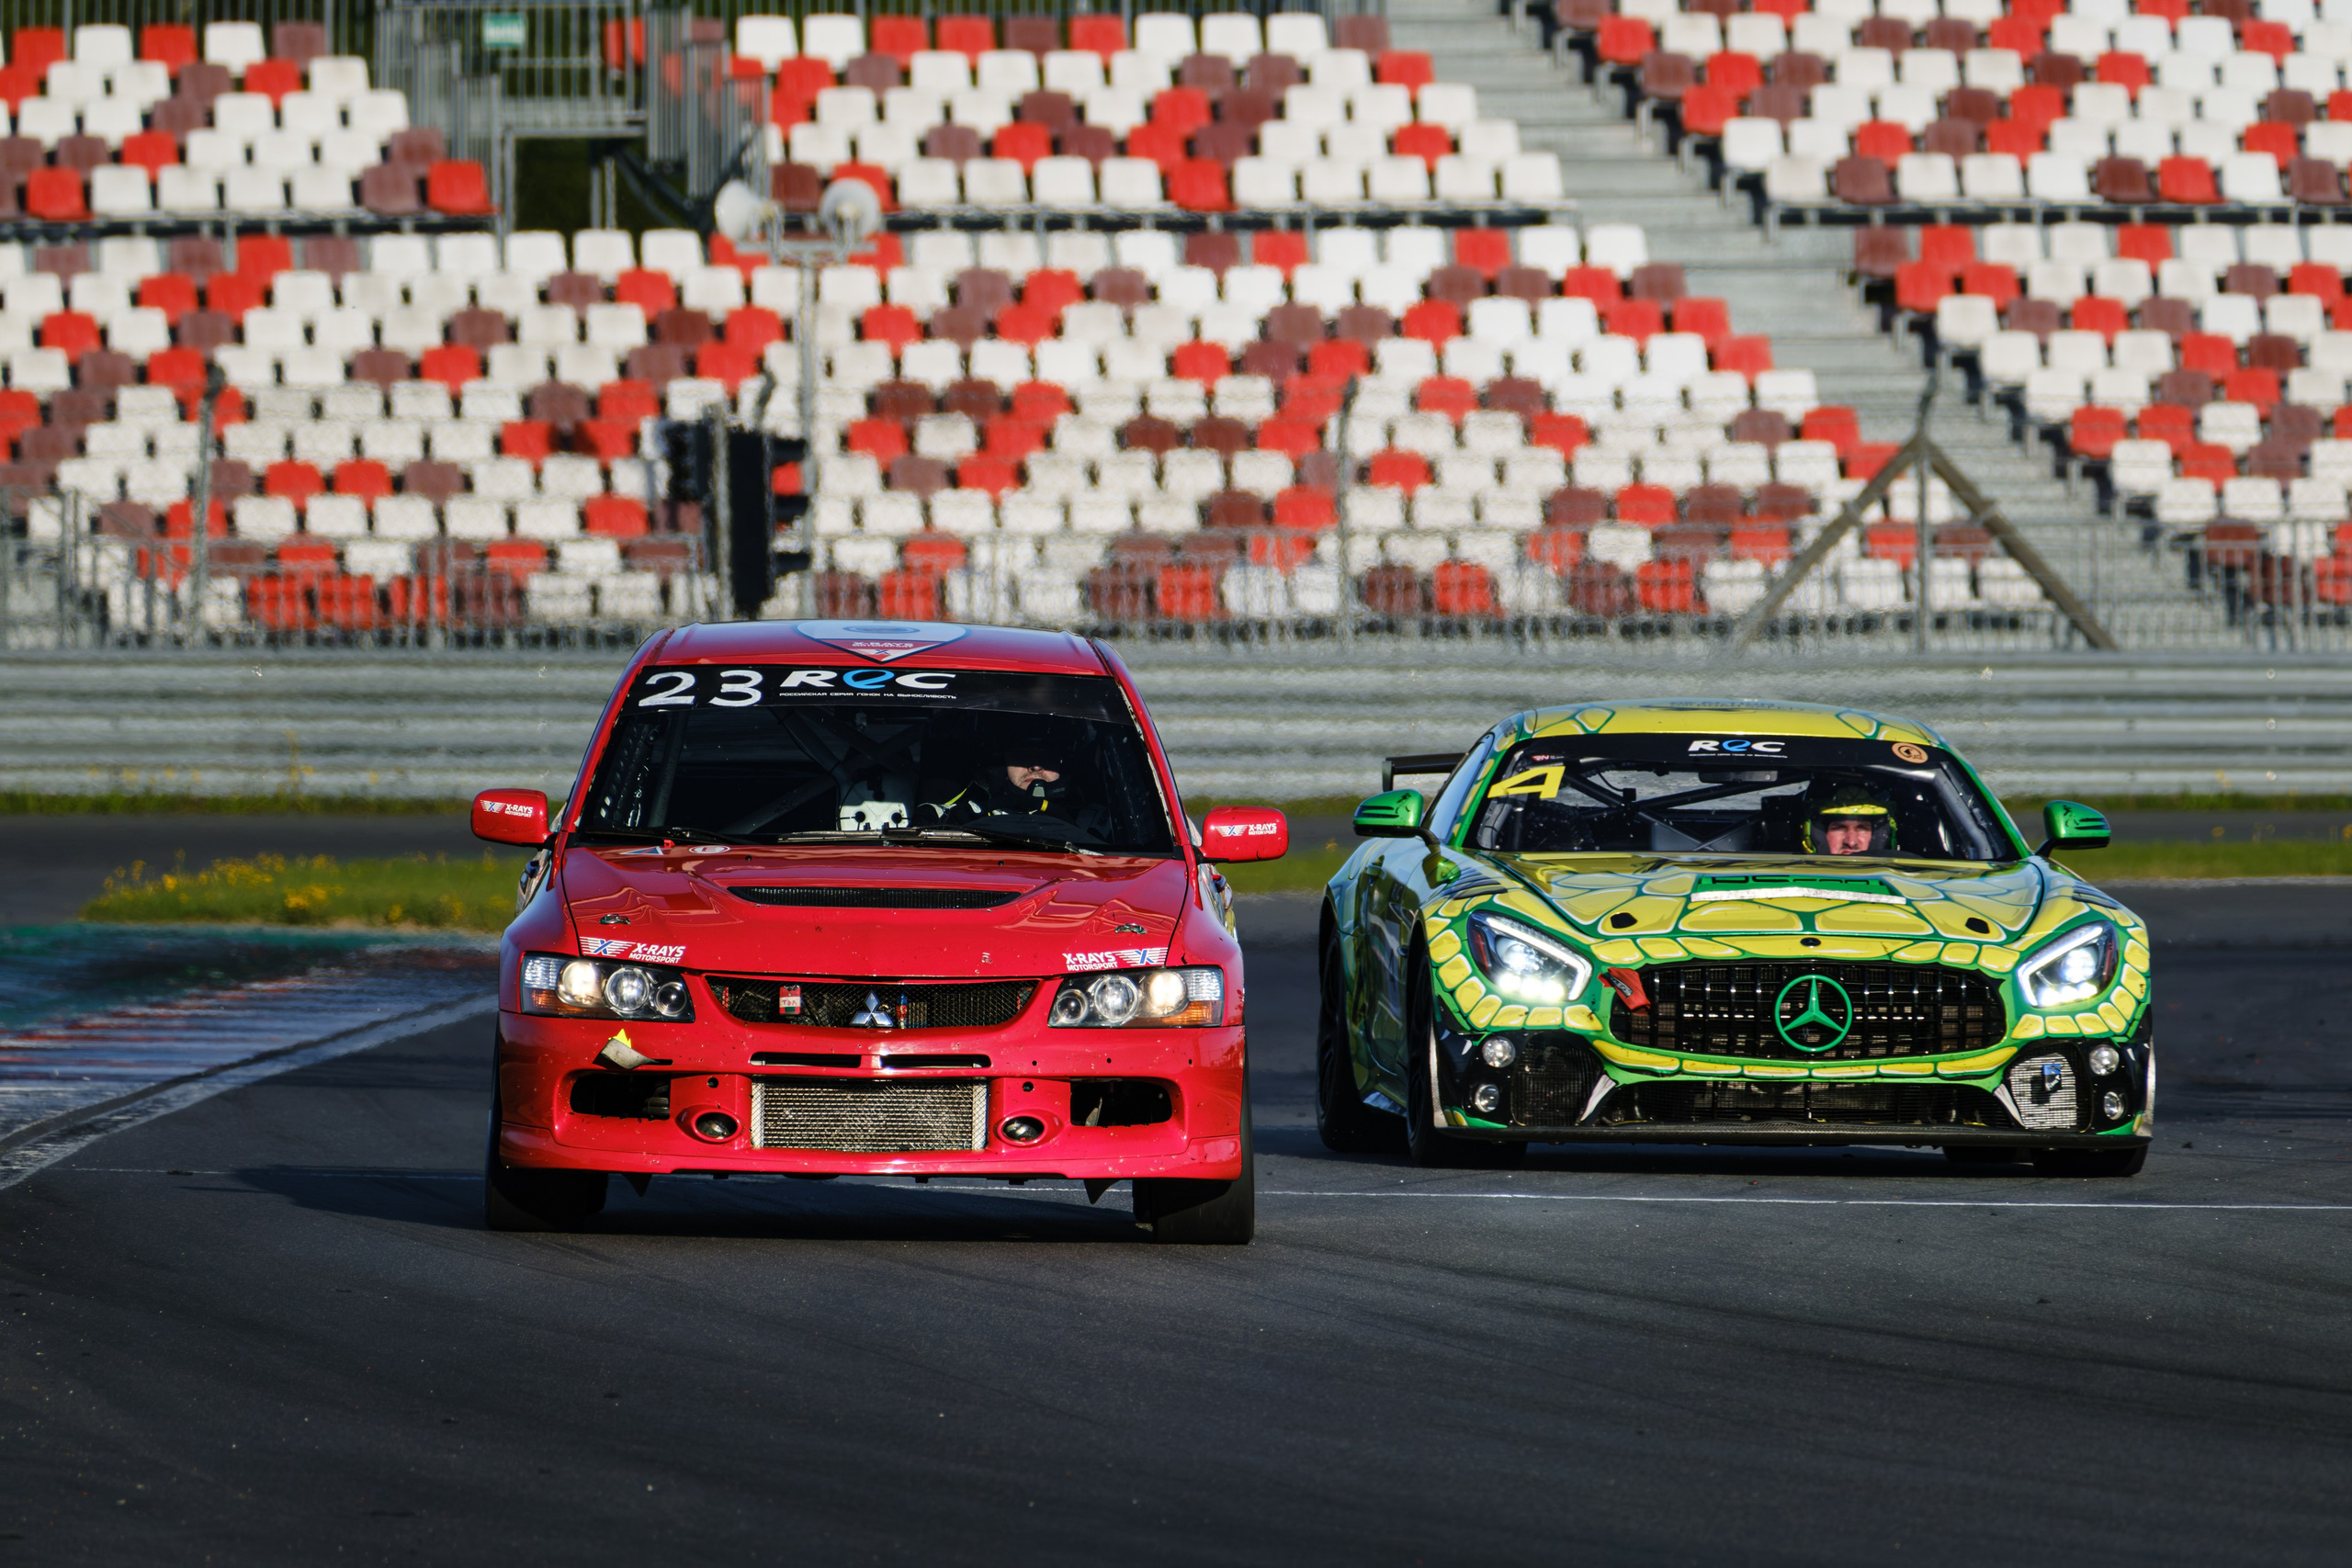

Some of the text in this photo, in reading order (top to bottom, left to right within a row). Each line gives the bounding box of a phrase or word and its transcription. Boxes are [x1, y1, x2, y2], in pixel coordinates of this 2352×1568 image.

[639, 670, 763, 706] 23
[505, 804, 534, 814] X-RAYS
[1249, 823, 1277, 831] X-RAYS
[632, 942, 686, 957] X-RAYS
[628, 953, 681, 964] MOTORSPORT
[1062, 951, 1116, 964] X-RAYS
[1066, 962, 1118, 972] MOTORSPORT
